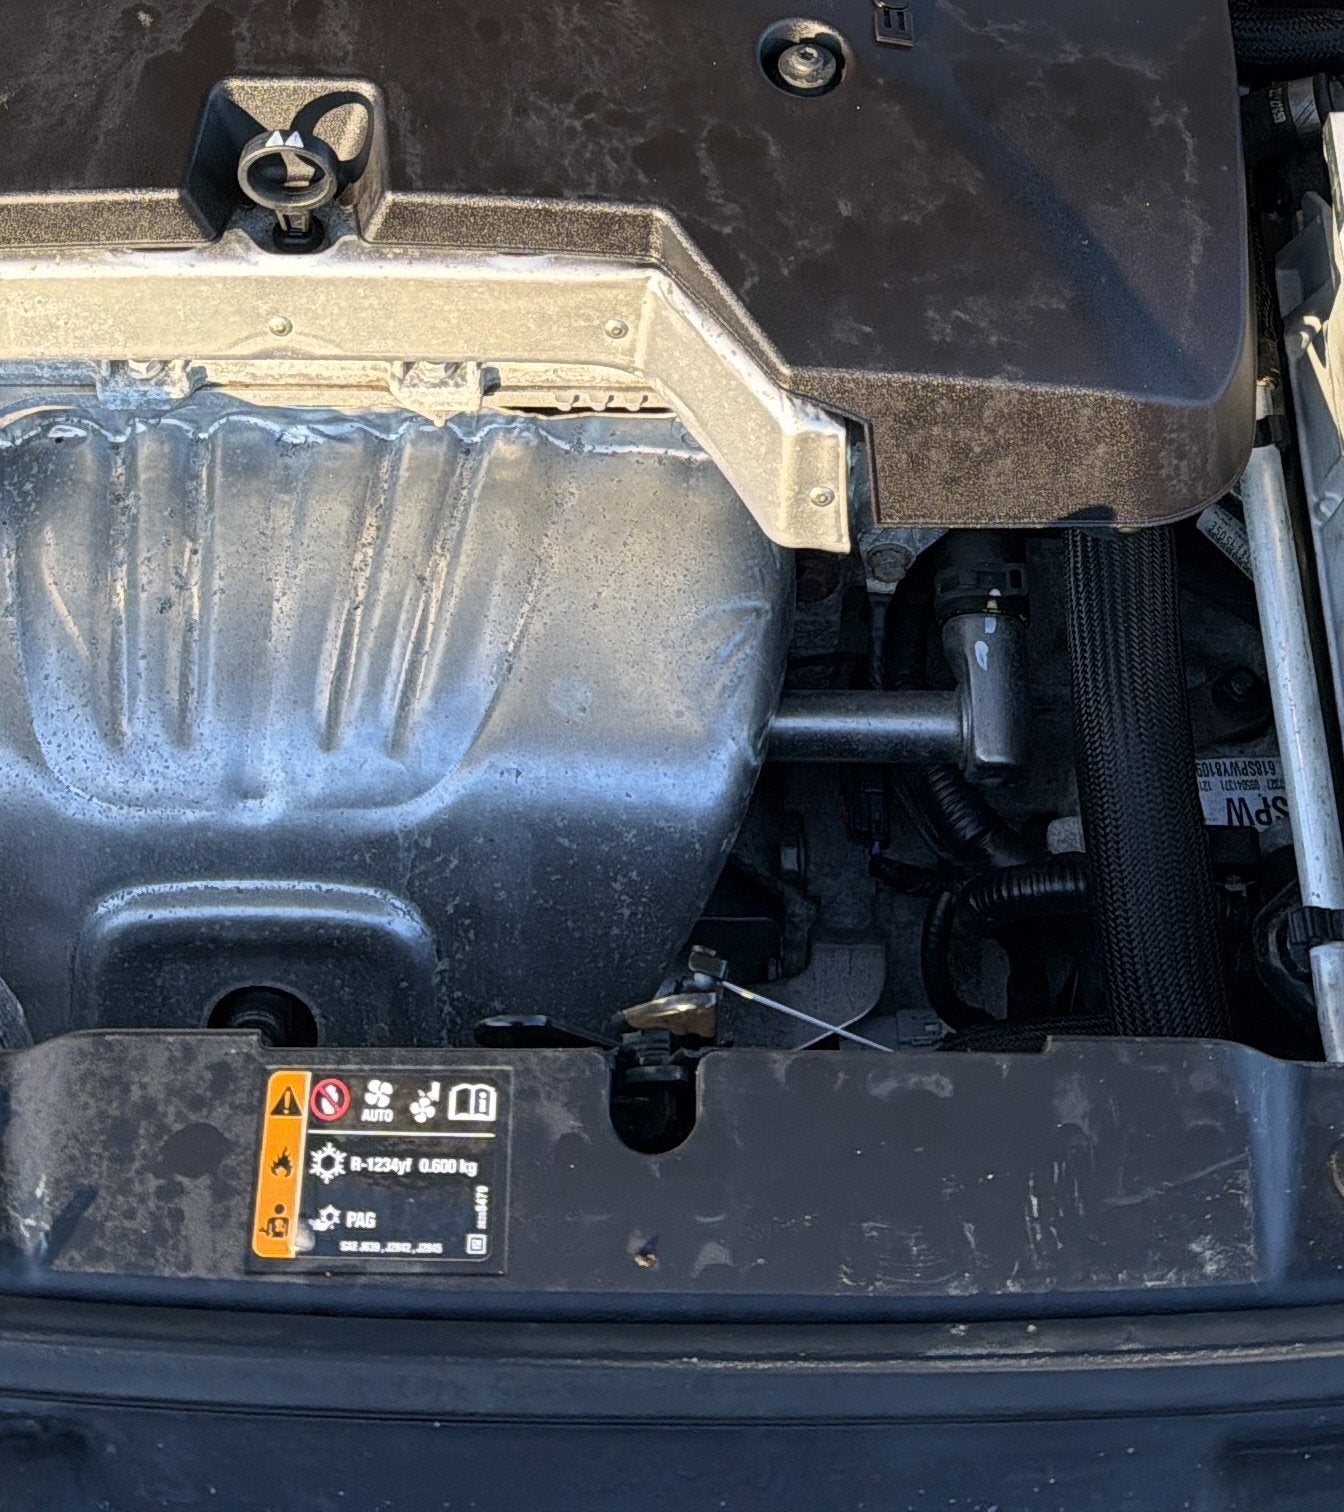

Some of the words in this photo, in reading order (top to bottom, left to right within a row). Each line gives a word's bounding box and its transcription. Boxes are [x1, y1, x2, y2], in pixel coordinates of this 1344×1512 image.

[361, 1109, 393, 1122] AUTO
[350, 1158, 412, 1177] R-1234yf
[418, 1158, 457, 1174] 0.600
[459, 1159, 478, 1177] kg
[346, 1211, 376, 1228] PAG
